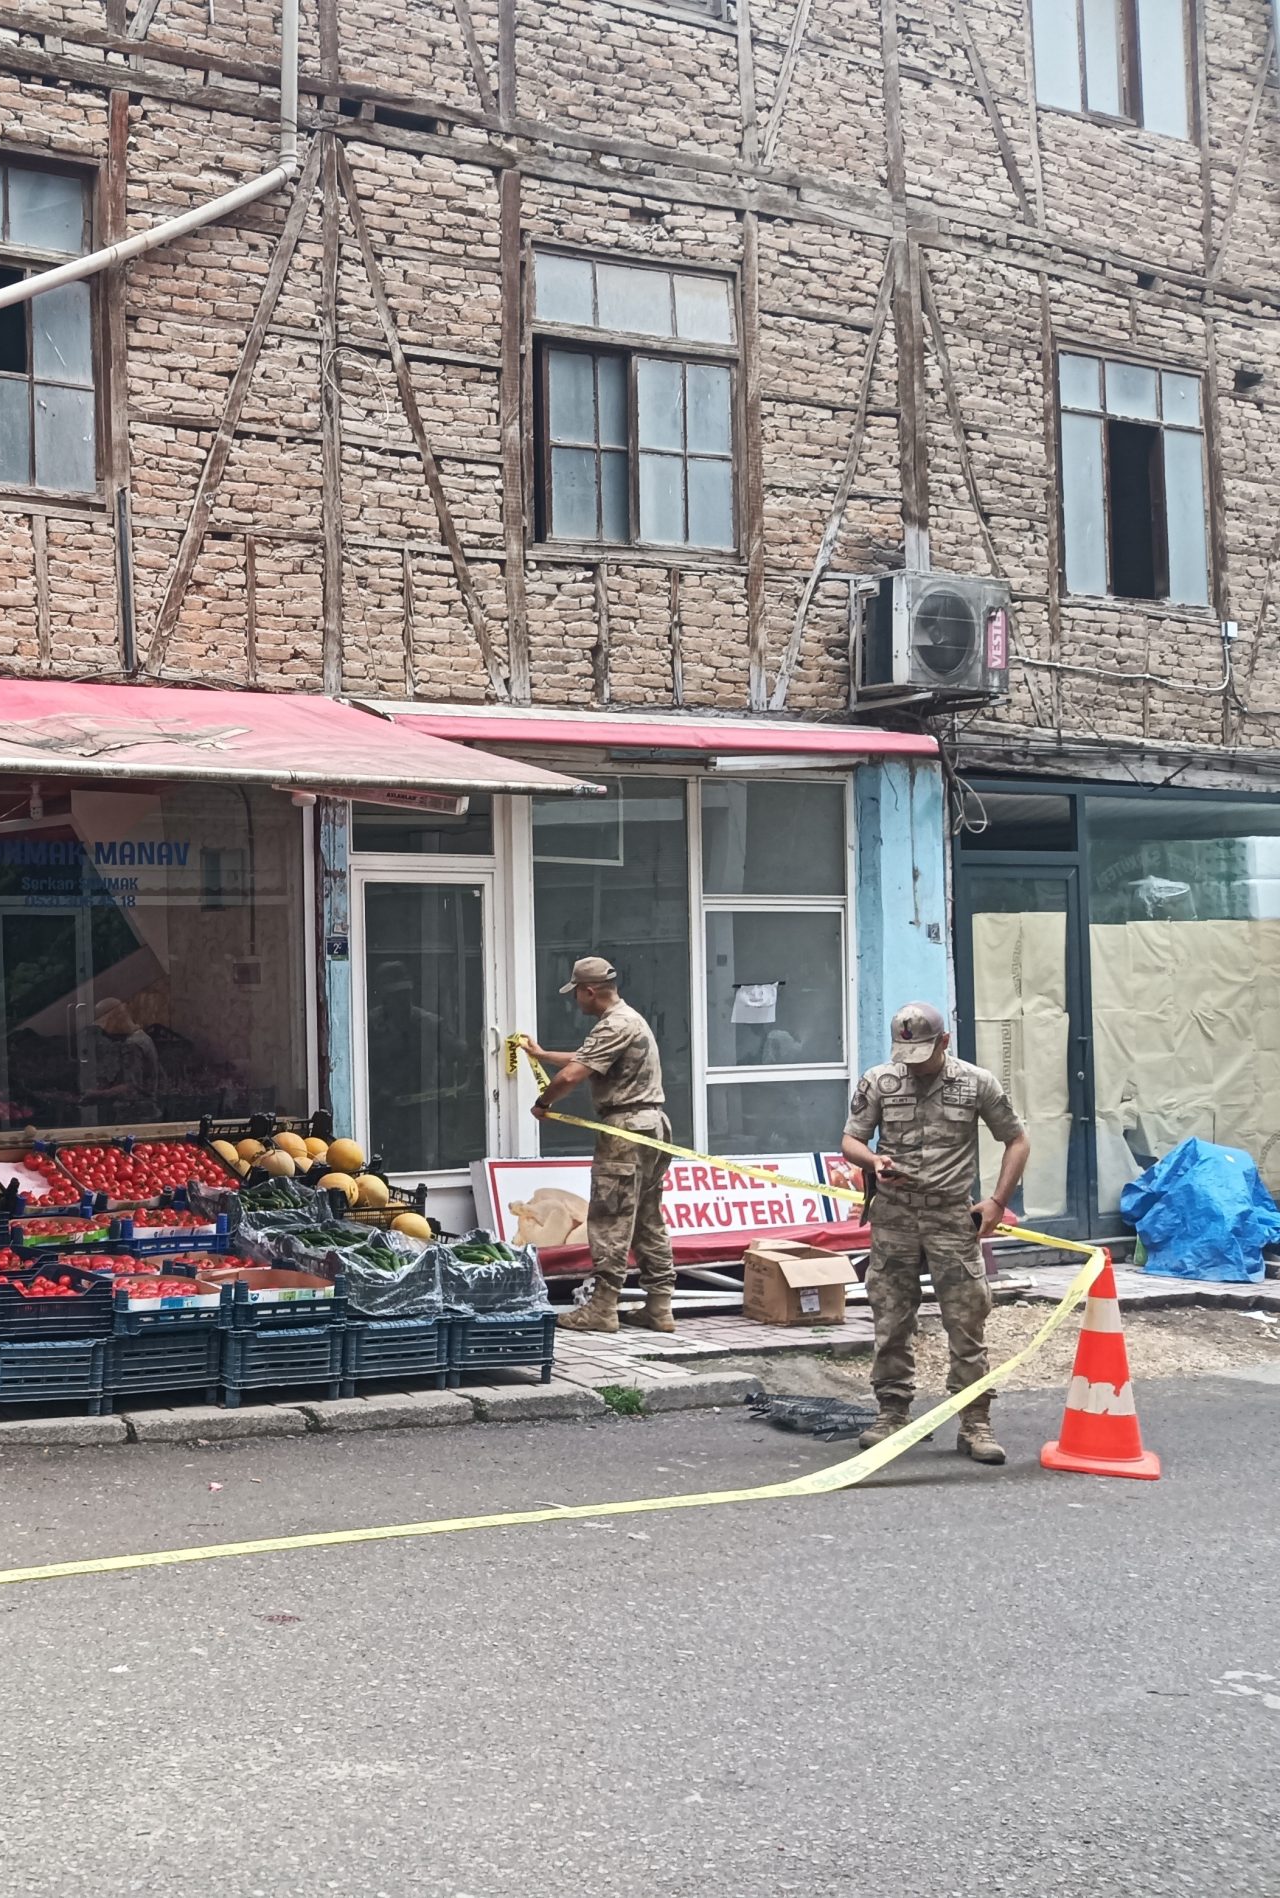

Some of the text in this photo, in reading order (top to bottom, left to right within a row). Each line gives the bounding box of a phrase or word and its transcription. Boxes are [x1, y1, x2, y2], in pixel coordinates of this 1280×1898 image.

[94, 841, 190, 865] MANAV
[21, 877, 74, 890] Serkan
[122, 895, 136, 907] 18
[660, 1193, 819, 1229] ARKÜTERİ 2
